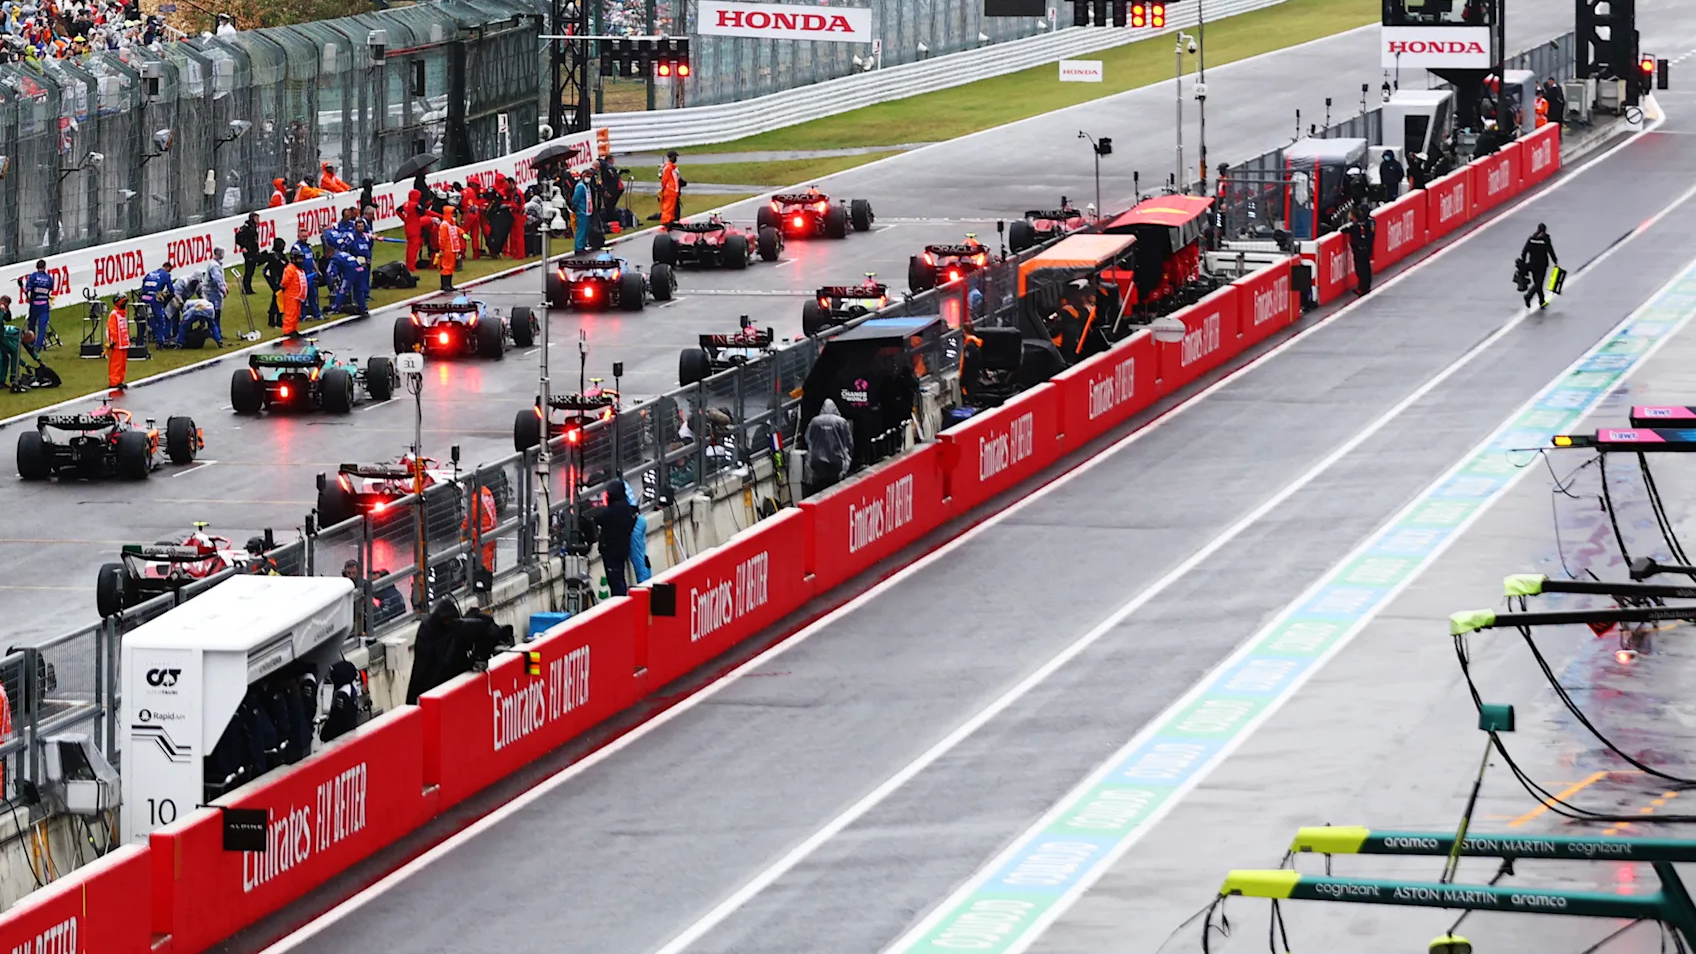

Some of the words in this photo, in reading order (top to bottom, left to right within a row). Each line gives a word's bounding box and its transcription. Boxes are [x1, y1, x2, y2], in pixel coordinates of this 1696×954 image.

[715, 9, 855, 34] HONDA
[1388, 39, 1486, 54] HONDA
[1062, 68, 1099, 76] HONDA
[167, 233, 215, 270] HONDA
[932, 245, 980, 254] ORACLE
[94, 249, 146, 287] HONDA
[19, 265, 71, 304] HDA
[832, 287, 874, 296] INEOS
[711, 334, 758, 345] INEOS
[259, 354, 312, 362] aramco
[979, 429, 1009, 482] Emirates
[849, 495, 885, 553] Emirates
[690, 577, 733, 642] Emirates
[735, 563, 747, 619] FLY
[746, 550, 769, 613] BETTER
[493, 672, 546, 751] Emirates
[548, 658, 564, 722] FLY
[563, 644, 591, 713] BETTER
[147, 798, 176, 826] 10
[315, 784, 333, 854] FLY
[332, 761, 368, 844] BETTER
[229, 823, 263, 831] ALPINE
[1383, 836, 1439, 849] aramco
[1460, 838, 1499, 852] STON
[1501, 839, 1556, 853] MARTIN
[1567, 841, 1632, 855] cognizant
[1314, 882, 1381, 898] cognizant
[1392, 886, 1440, 902] ASTON
[1443, 889, 1498, 904] MARTIN
[1511, 893, 1567, 908] aramco
